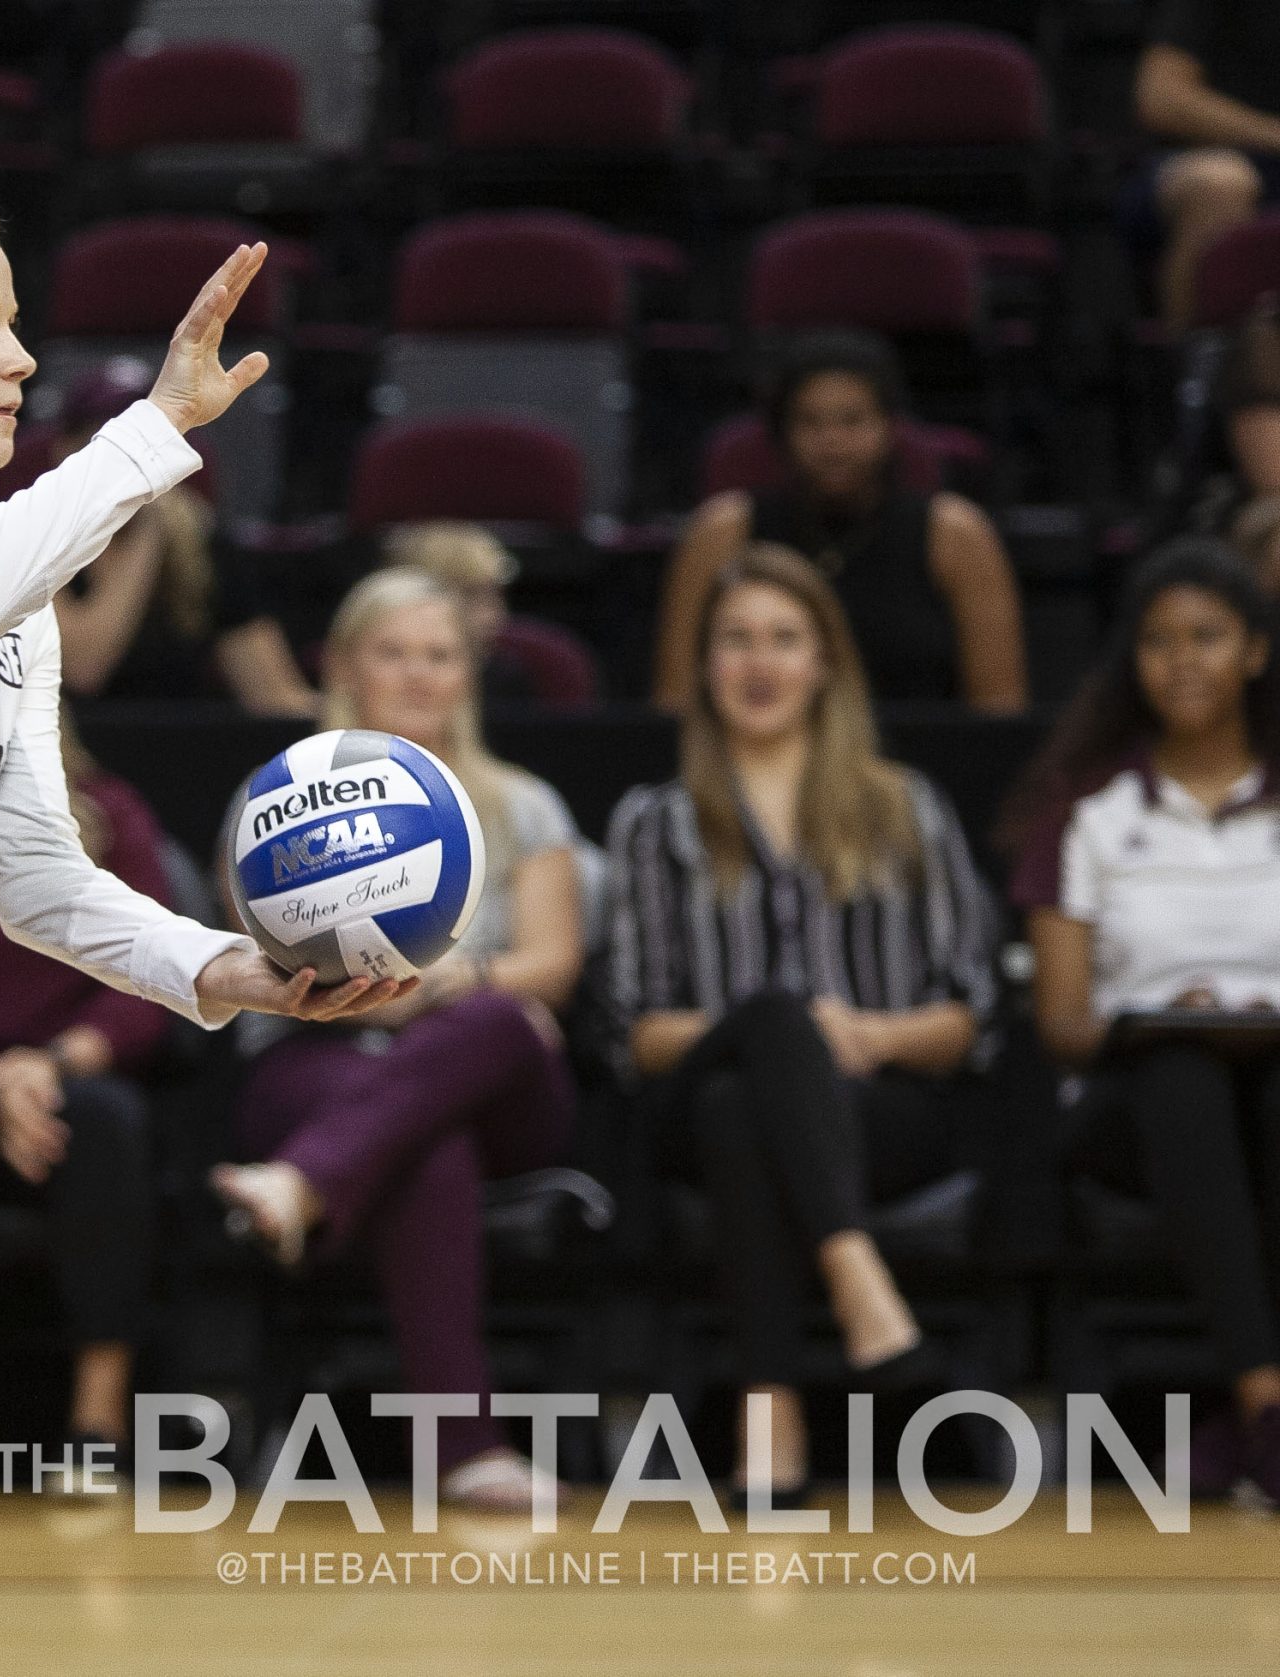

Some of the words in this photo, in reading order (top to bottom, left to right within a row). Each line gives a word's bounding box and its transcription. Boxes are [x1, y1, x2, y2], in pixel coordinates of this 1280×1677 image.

[253, 776, 387, 841] molten
[282, 898, 340, 927] Super
[346, 867, 411, 904] Touch
